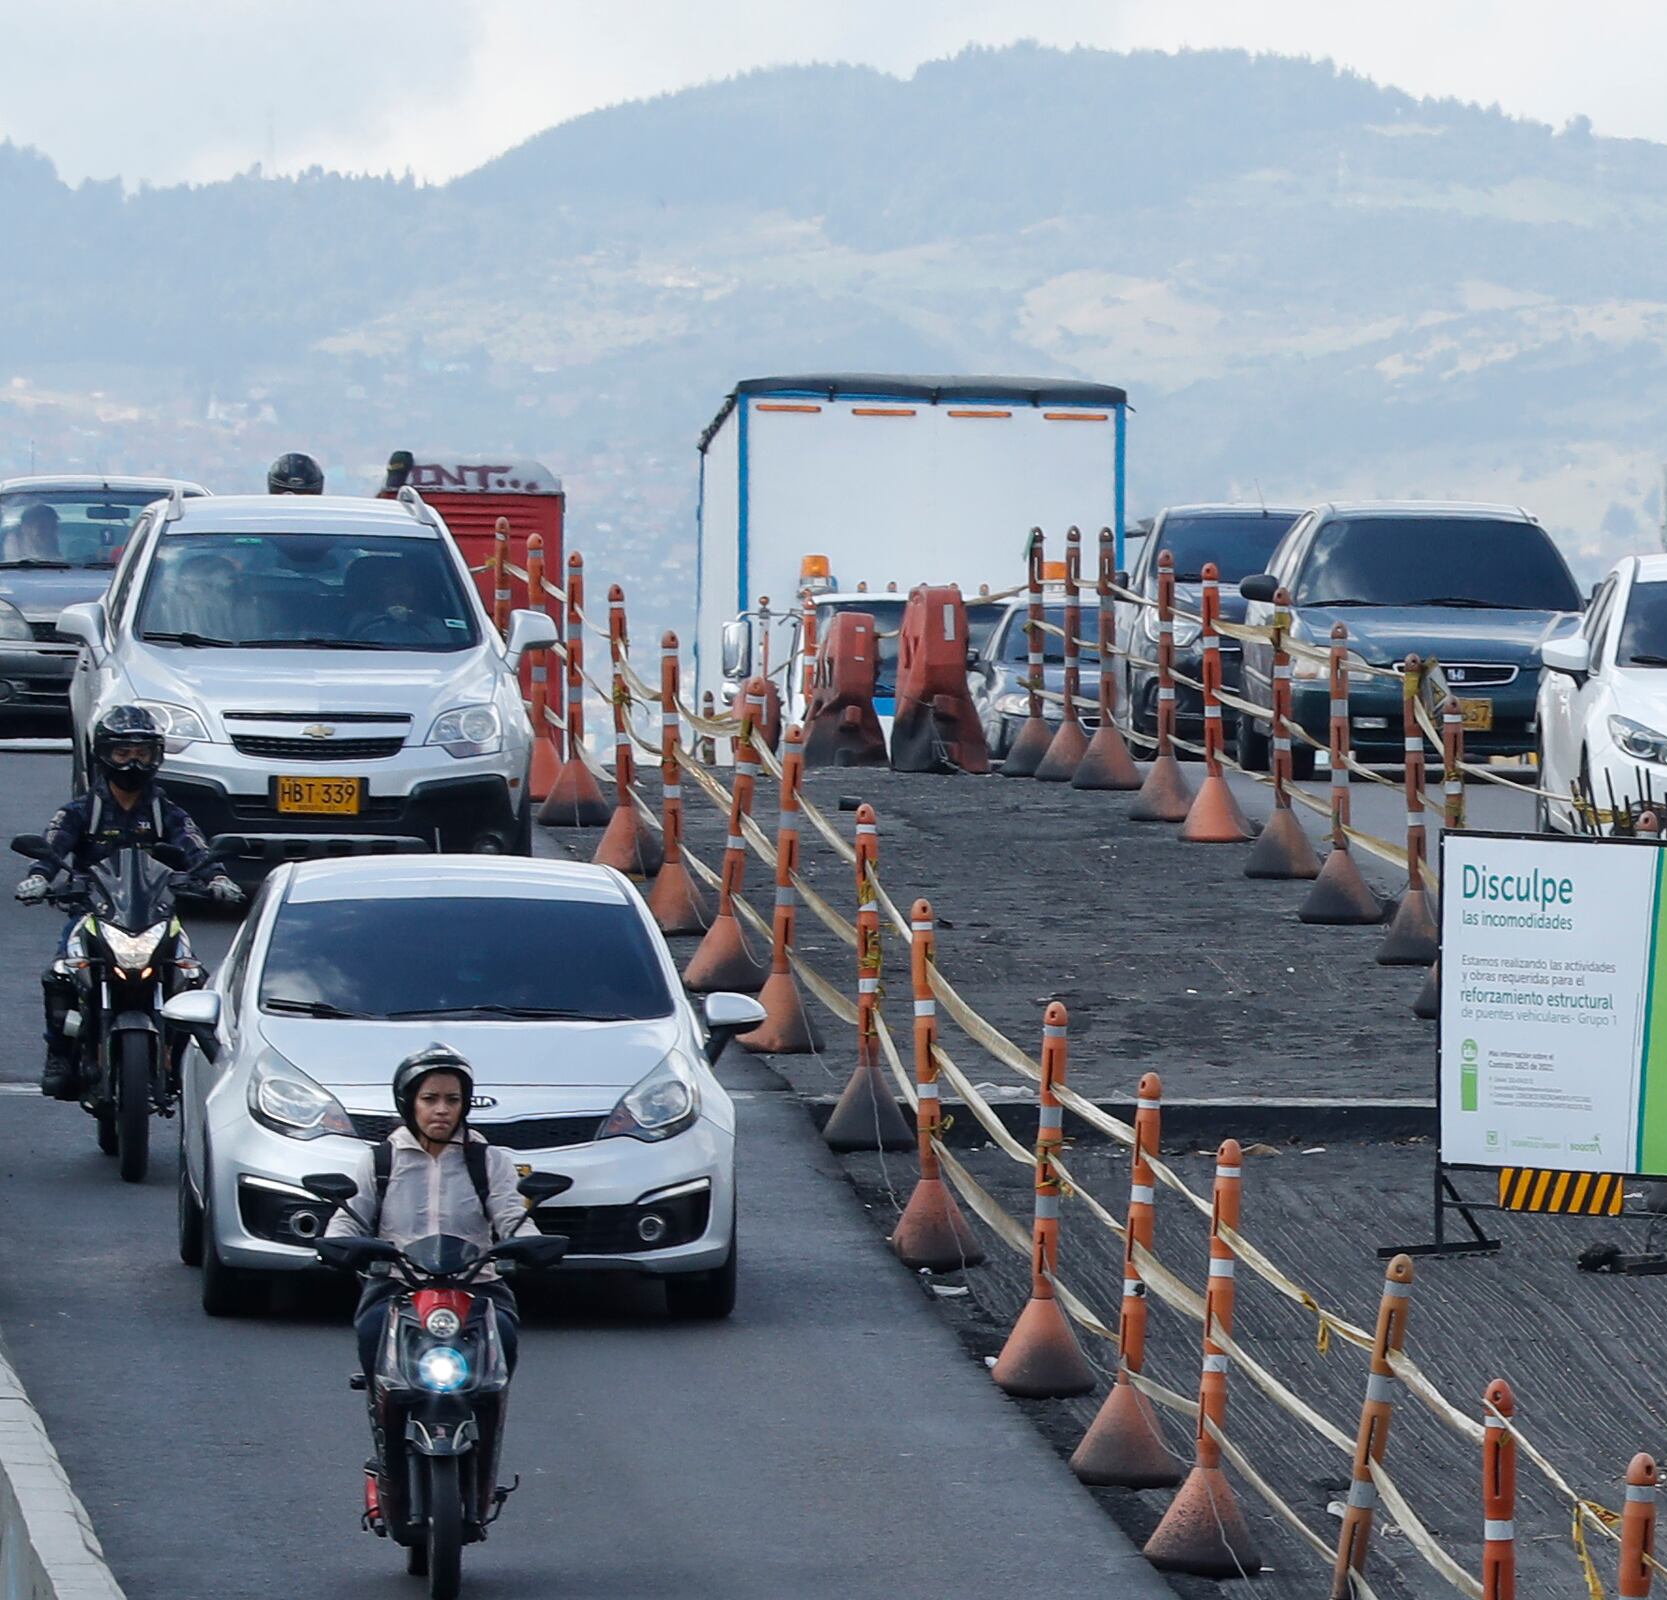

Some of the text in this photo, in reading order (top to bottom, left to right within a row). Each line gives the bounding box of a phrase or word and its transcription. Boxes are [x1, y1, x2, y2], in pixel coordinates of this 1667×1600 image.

[1462, 864, 1573, 911] Disculpe
[1462, 910, 1573, 930] las incomodidades
[1462, 955, 1616, 973] Estamos realizando las actividades
[1462, 971, 1585, 987] y obras requeridas para el
[1460, 986, 1614, 1010] reforzamiento estructural
[1461, 1007, 1474, 1019] de
[1475, 1009, 1514, 1022] puentes
[1578, 1012, 1609, 1027] Grupo
